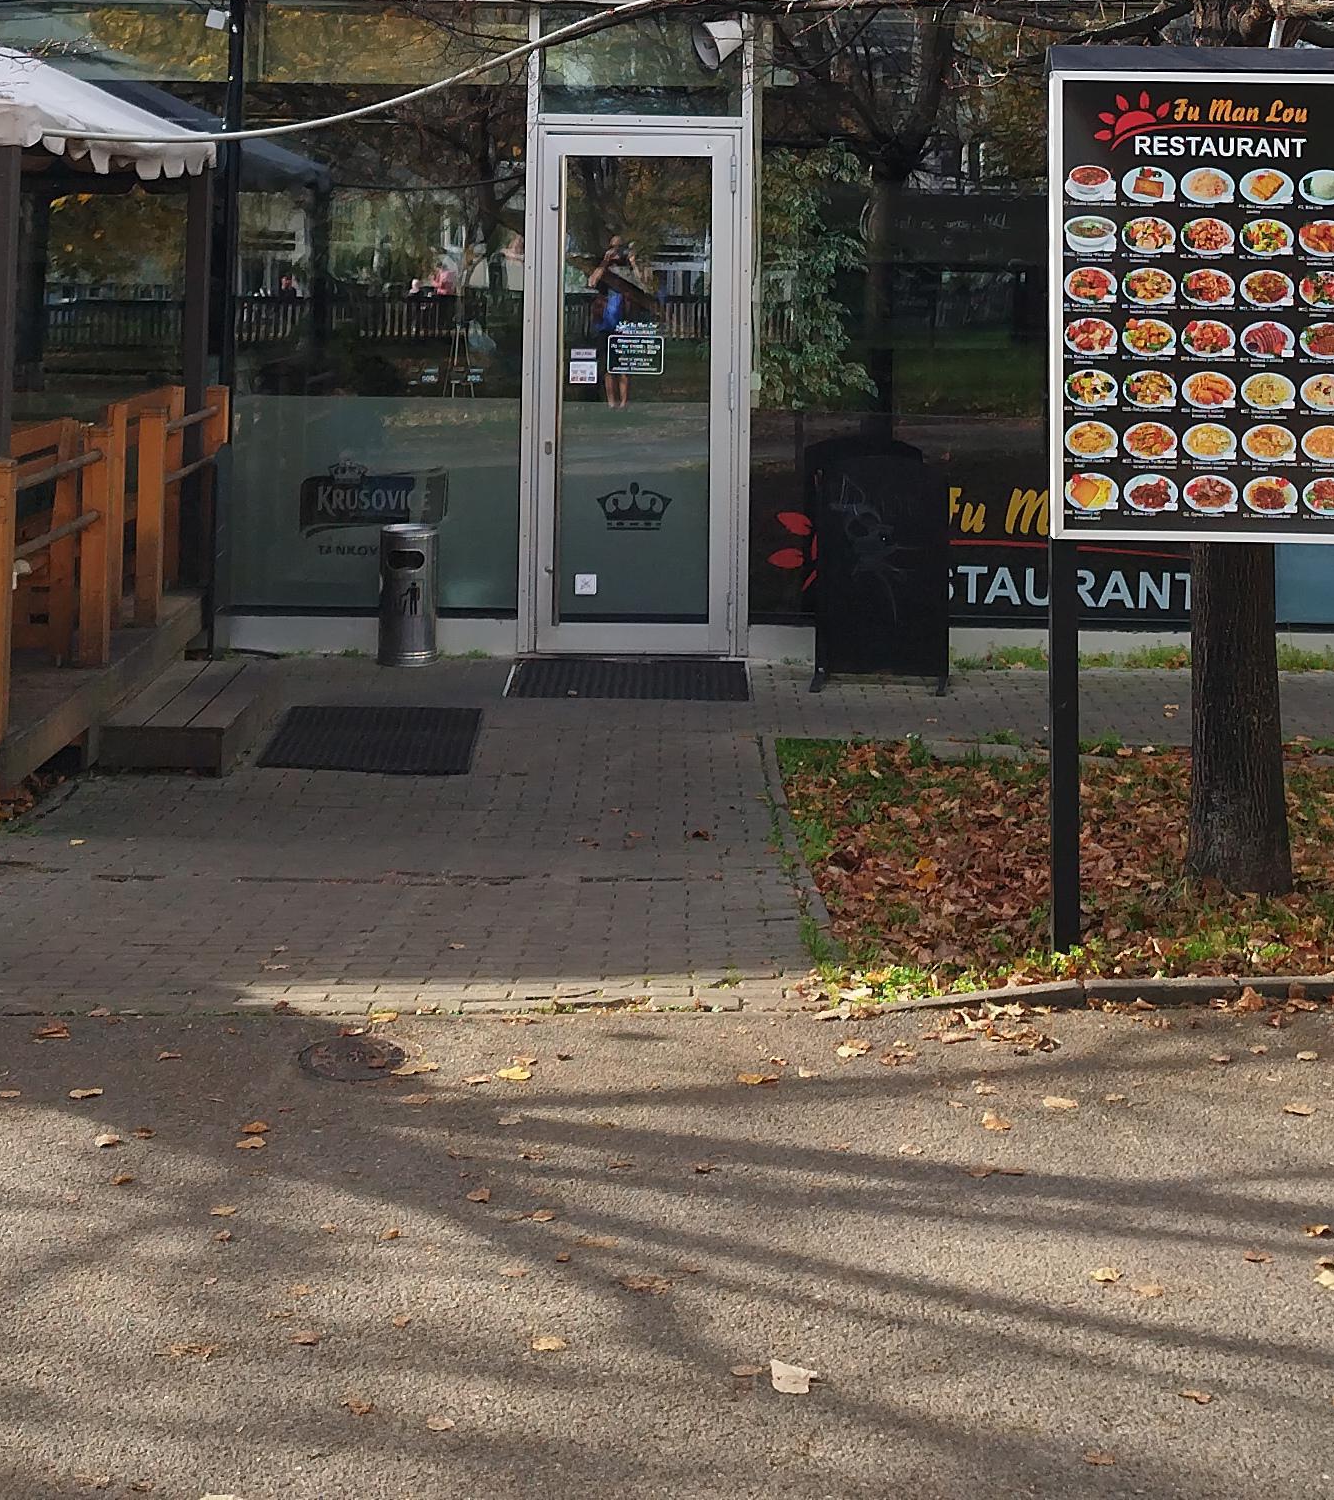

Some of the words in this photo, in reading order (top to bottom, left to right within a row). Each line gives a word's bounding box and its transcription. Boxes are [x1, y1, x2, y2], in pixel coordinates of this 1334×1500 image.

[1173, 98, 1200, 122] Fu
[1208, 98, 1259, 123] Man
[1265, 99, 1308, 124] Lou
[1134, 135, 1308, 158] RESTAURANT
